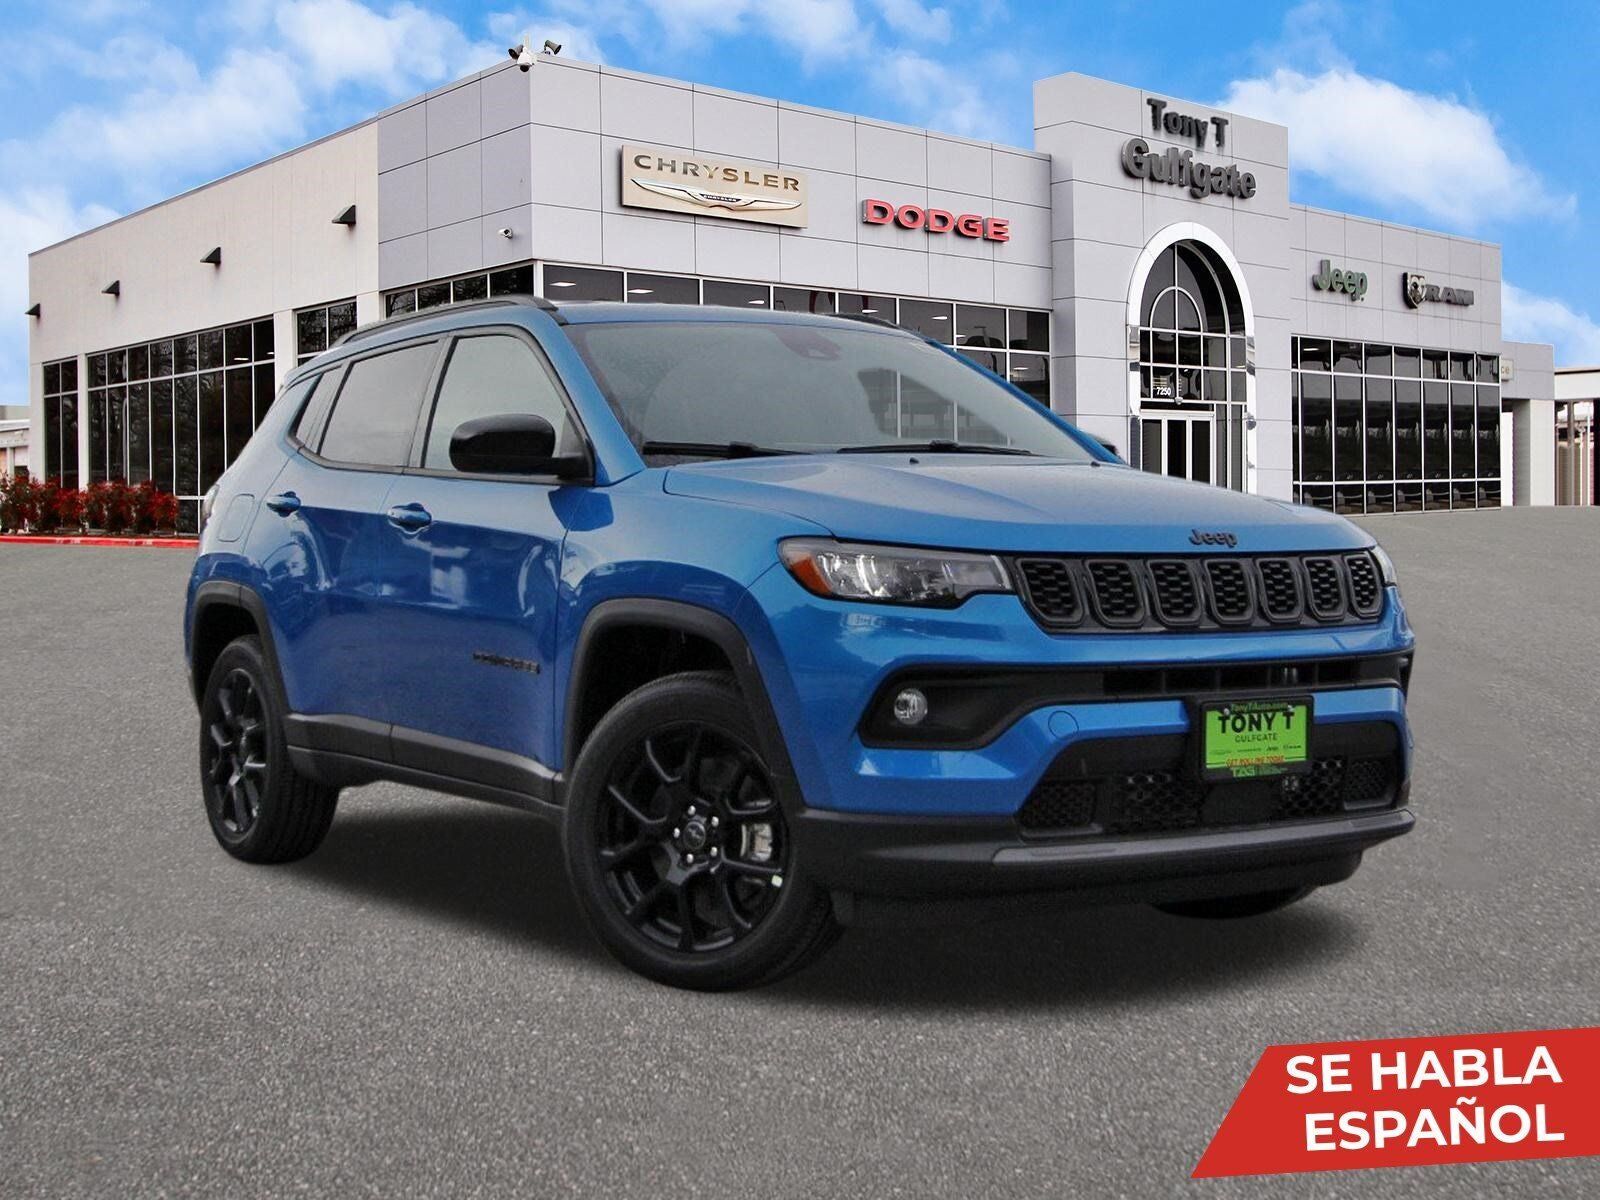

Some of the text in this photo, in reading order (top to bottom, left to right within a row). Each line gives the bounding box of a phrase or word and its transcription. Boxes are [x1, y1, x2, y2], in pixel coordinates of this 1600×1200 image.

[1146, 98, 1229, 147] Tony T
[633, 154, 800, 192] CHRYSLER
[1121, 138, 1256, 199] Gulfgate
[862, 198, 1011, 243] DODGE
[1312, 259, 1368, 302] Jeep
[1425, 284, 1474, 306] RAM
[1156, 386, 1172, 397] 7250
[1188, 528, 1238, 549] Jeep
[1218, 711, 1295, 733] TONY T
